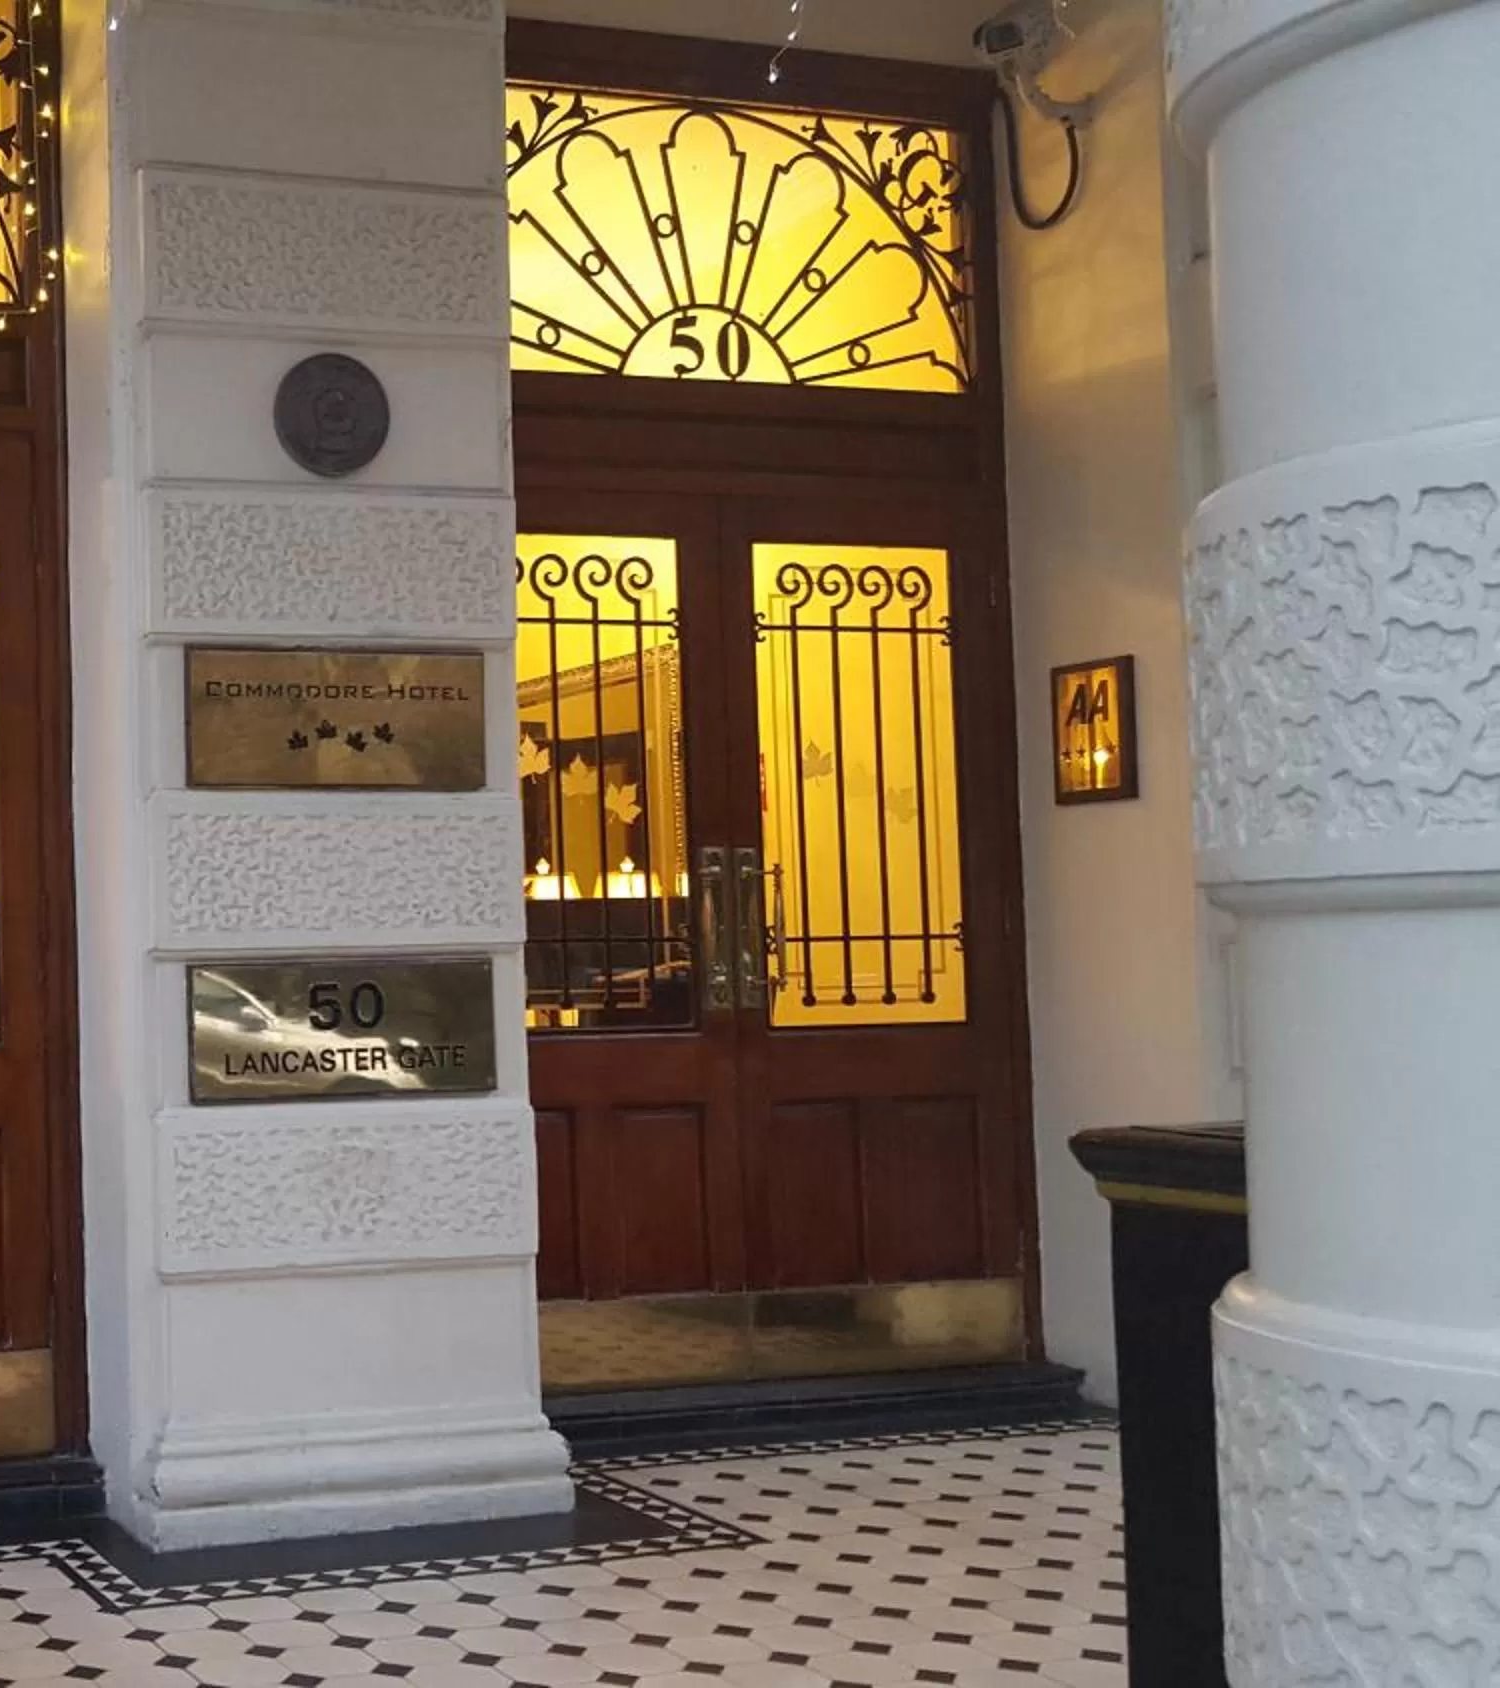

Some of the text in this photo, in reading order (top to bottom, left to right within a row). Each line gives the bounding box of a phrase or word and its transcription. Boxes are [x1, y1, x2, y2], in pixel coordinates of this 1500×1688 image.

[670, 315, 751, 377] 50
[204, 680, 470, 701] COMMODORE HOTEL
[1066, 679, 1109, 726] AA
[308, 980, 385, 1031] 50
[224, 1044, 467, 1076] LANCASTER GATE
